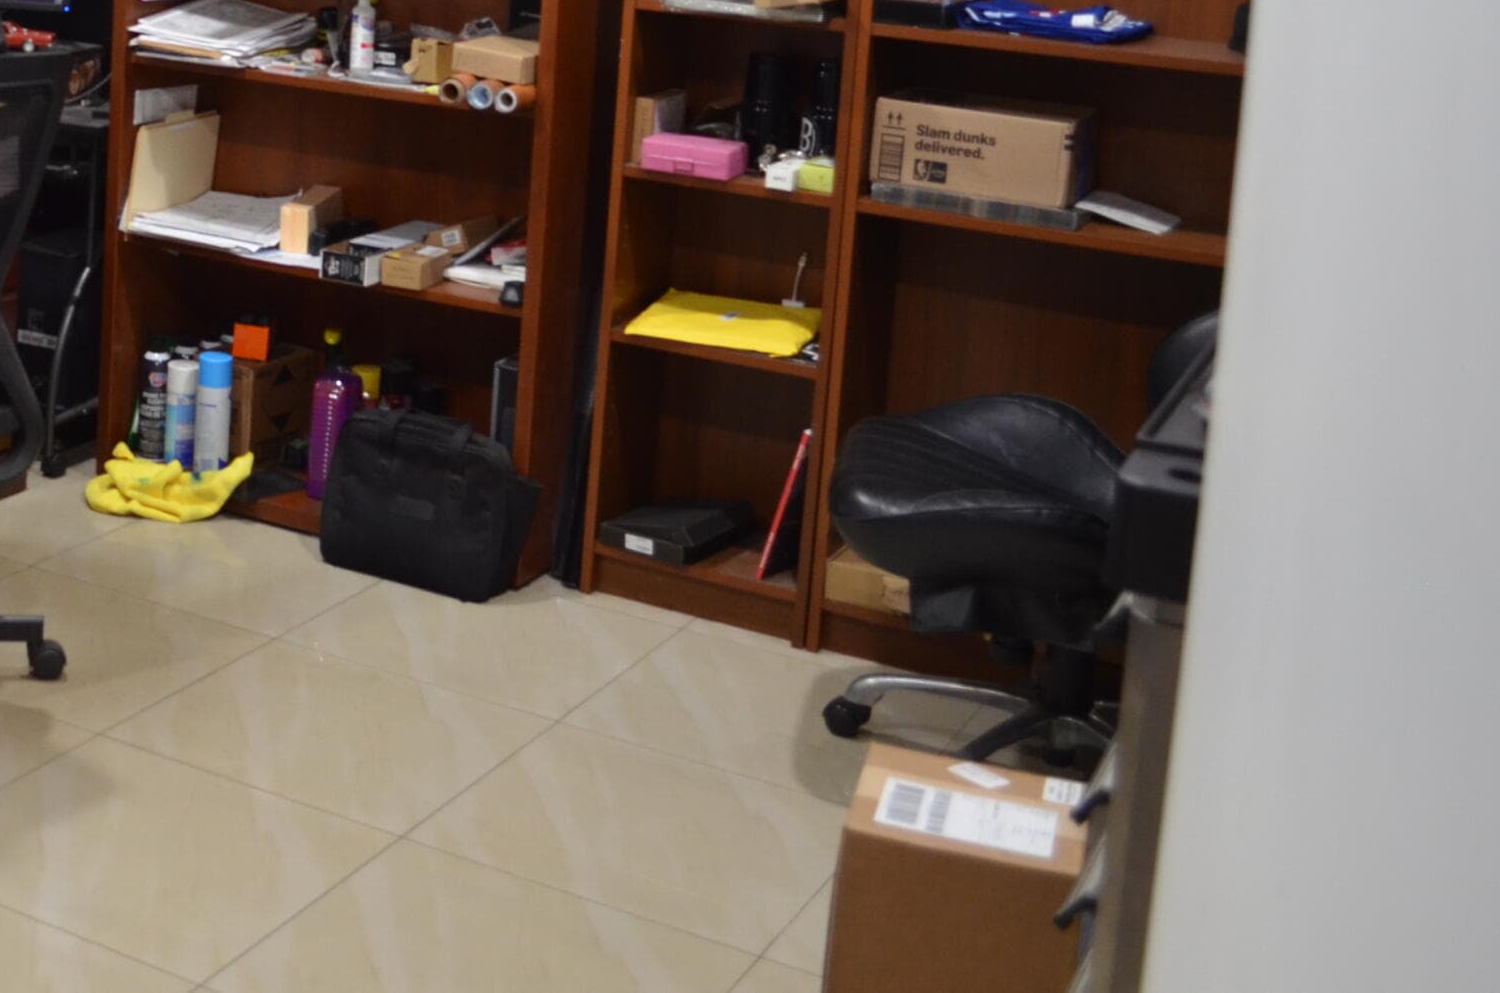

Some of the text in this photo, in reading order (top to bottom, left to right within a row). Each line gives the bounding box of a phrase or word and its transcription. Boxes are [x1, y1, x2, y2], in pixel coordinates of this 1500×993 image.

[916, 123, 996, 146] Slam dunks
[915, 139, 985, 160] delivered.
